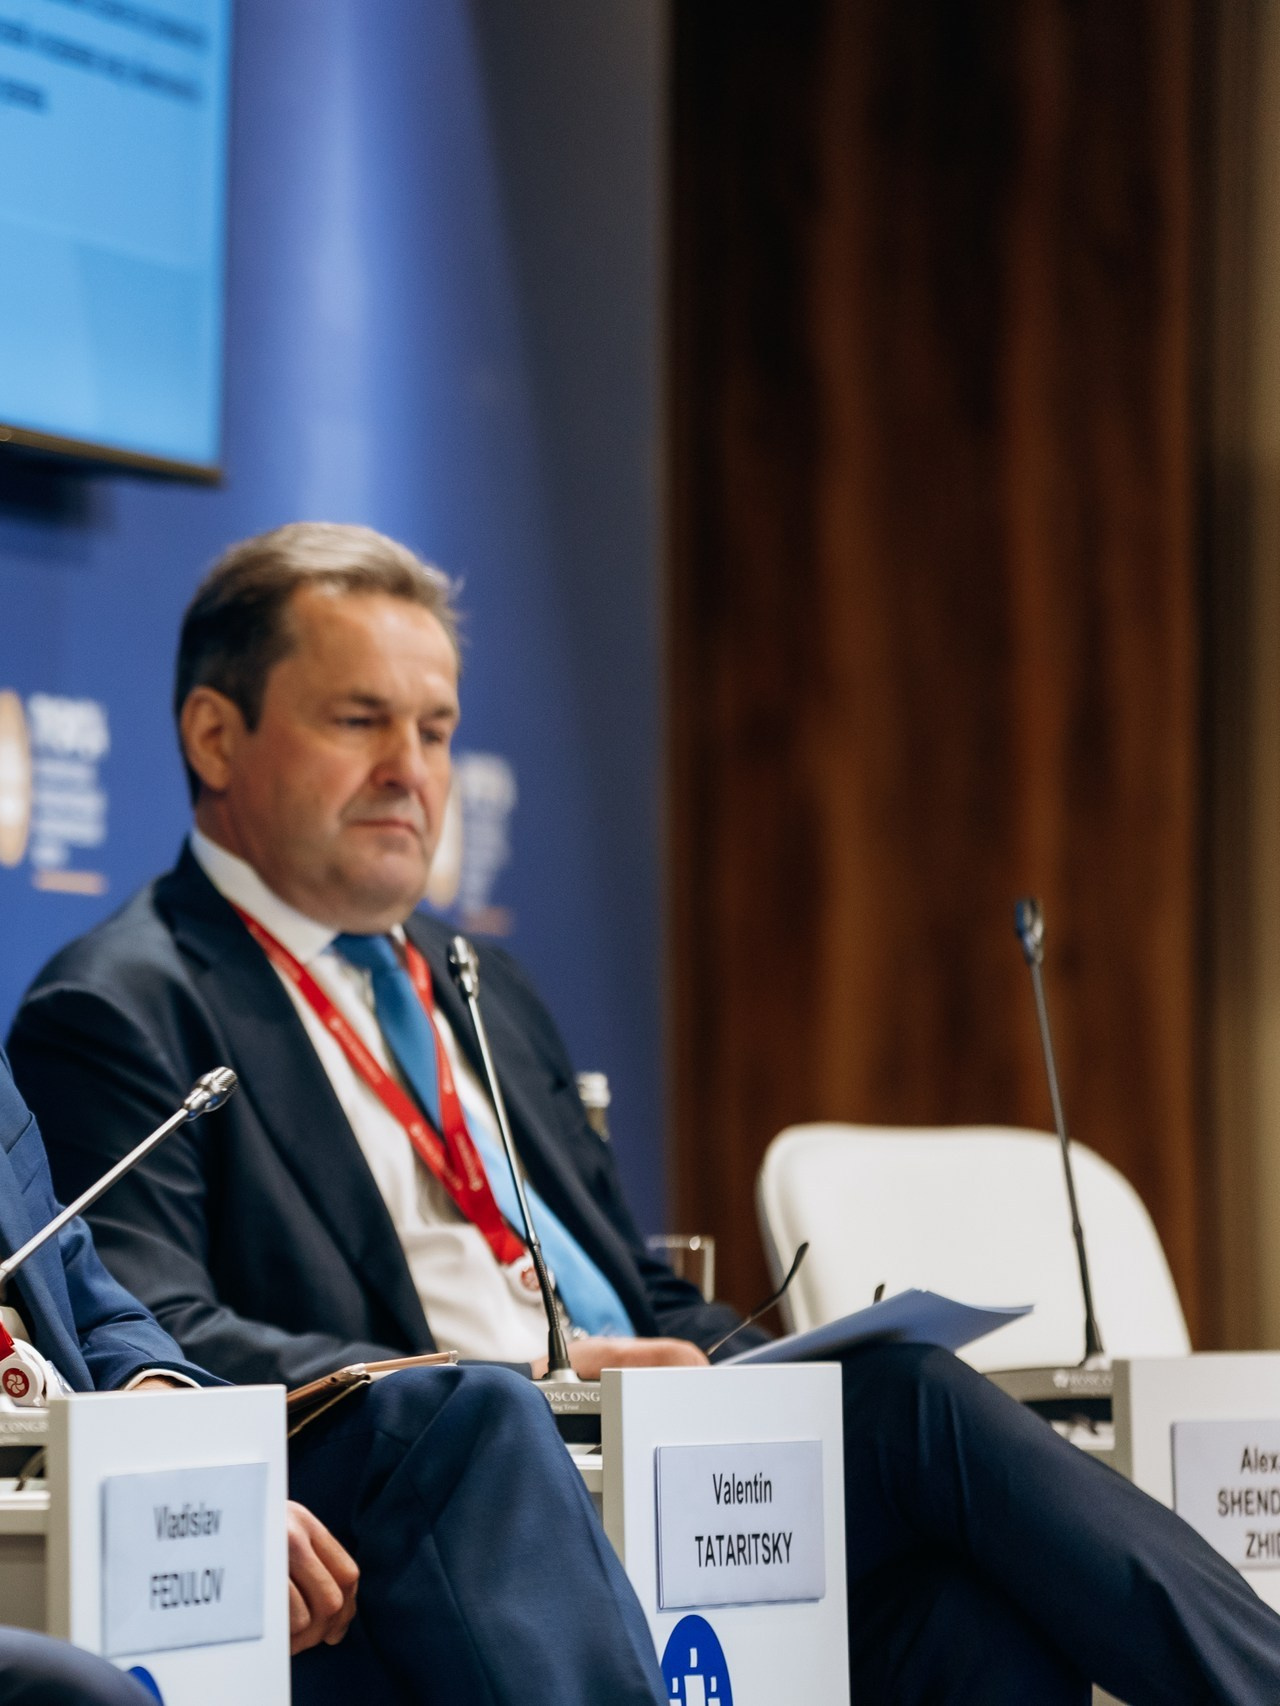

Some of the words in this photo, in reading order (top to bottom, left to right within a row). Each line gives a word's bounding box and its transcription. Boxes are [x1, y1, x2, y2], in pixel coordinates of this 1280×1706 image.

[1240, 1446, 1280, 1474] Alex
[712, 1472, 773, 1505] Valentin
[153, 1502, 222, 1541] Vladislav
[695, 1532, 793, 1567] TATARITSKY
[149, 1567, 224, 1610] FEDULOV
